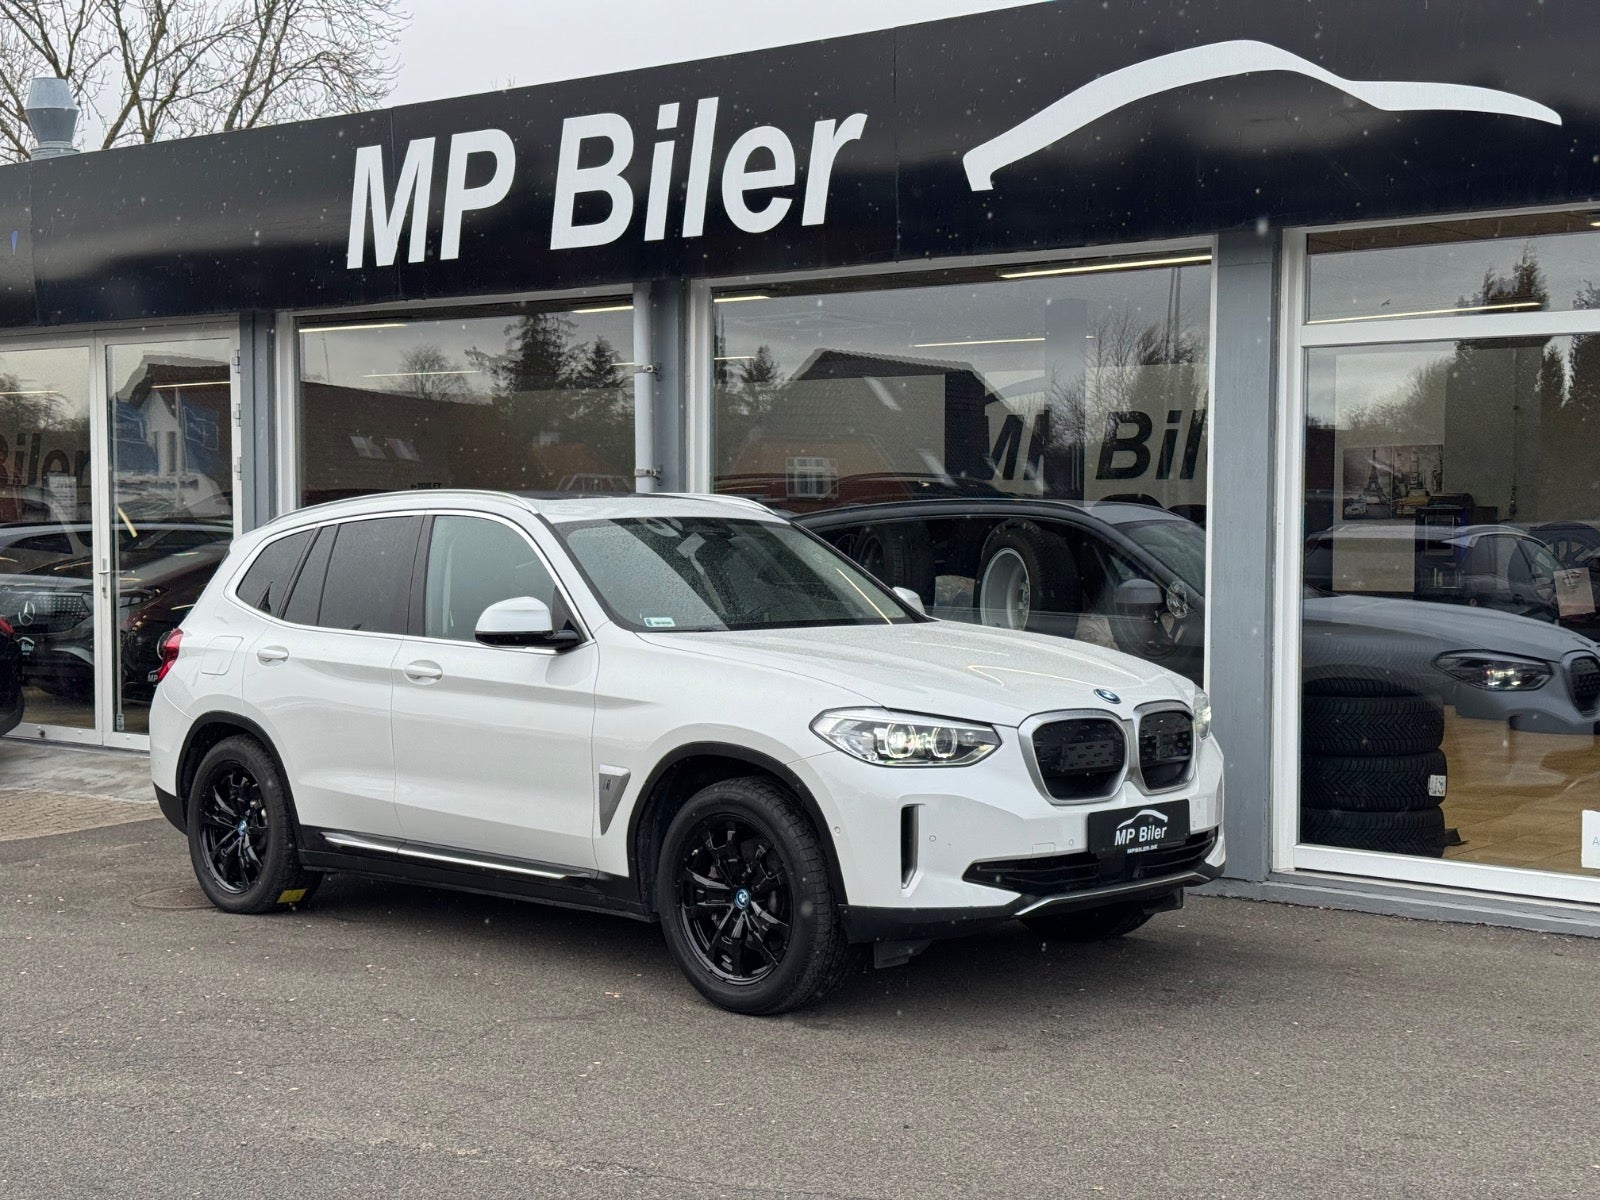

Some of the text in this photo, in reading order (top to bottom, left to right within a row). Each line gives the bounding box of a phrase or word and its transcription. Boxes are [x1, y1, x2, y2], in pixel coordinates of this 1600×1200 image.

[347, 97, 868, 269] MP Biler
[1096, 410, 1208, 480] Bil
[1114, 825, 1168, 846] MP Biler
